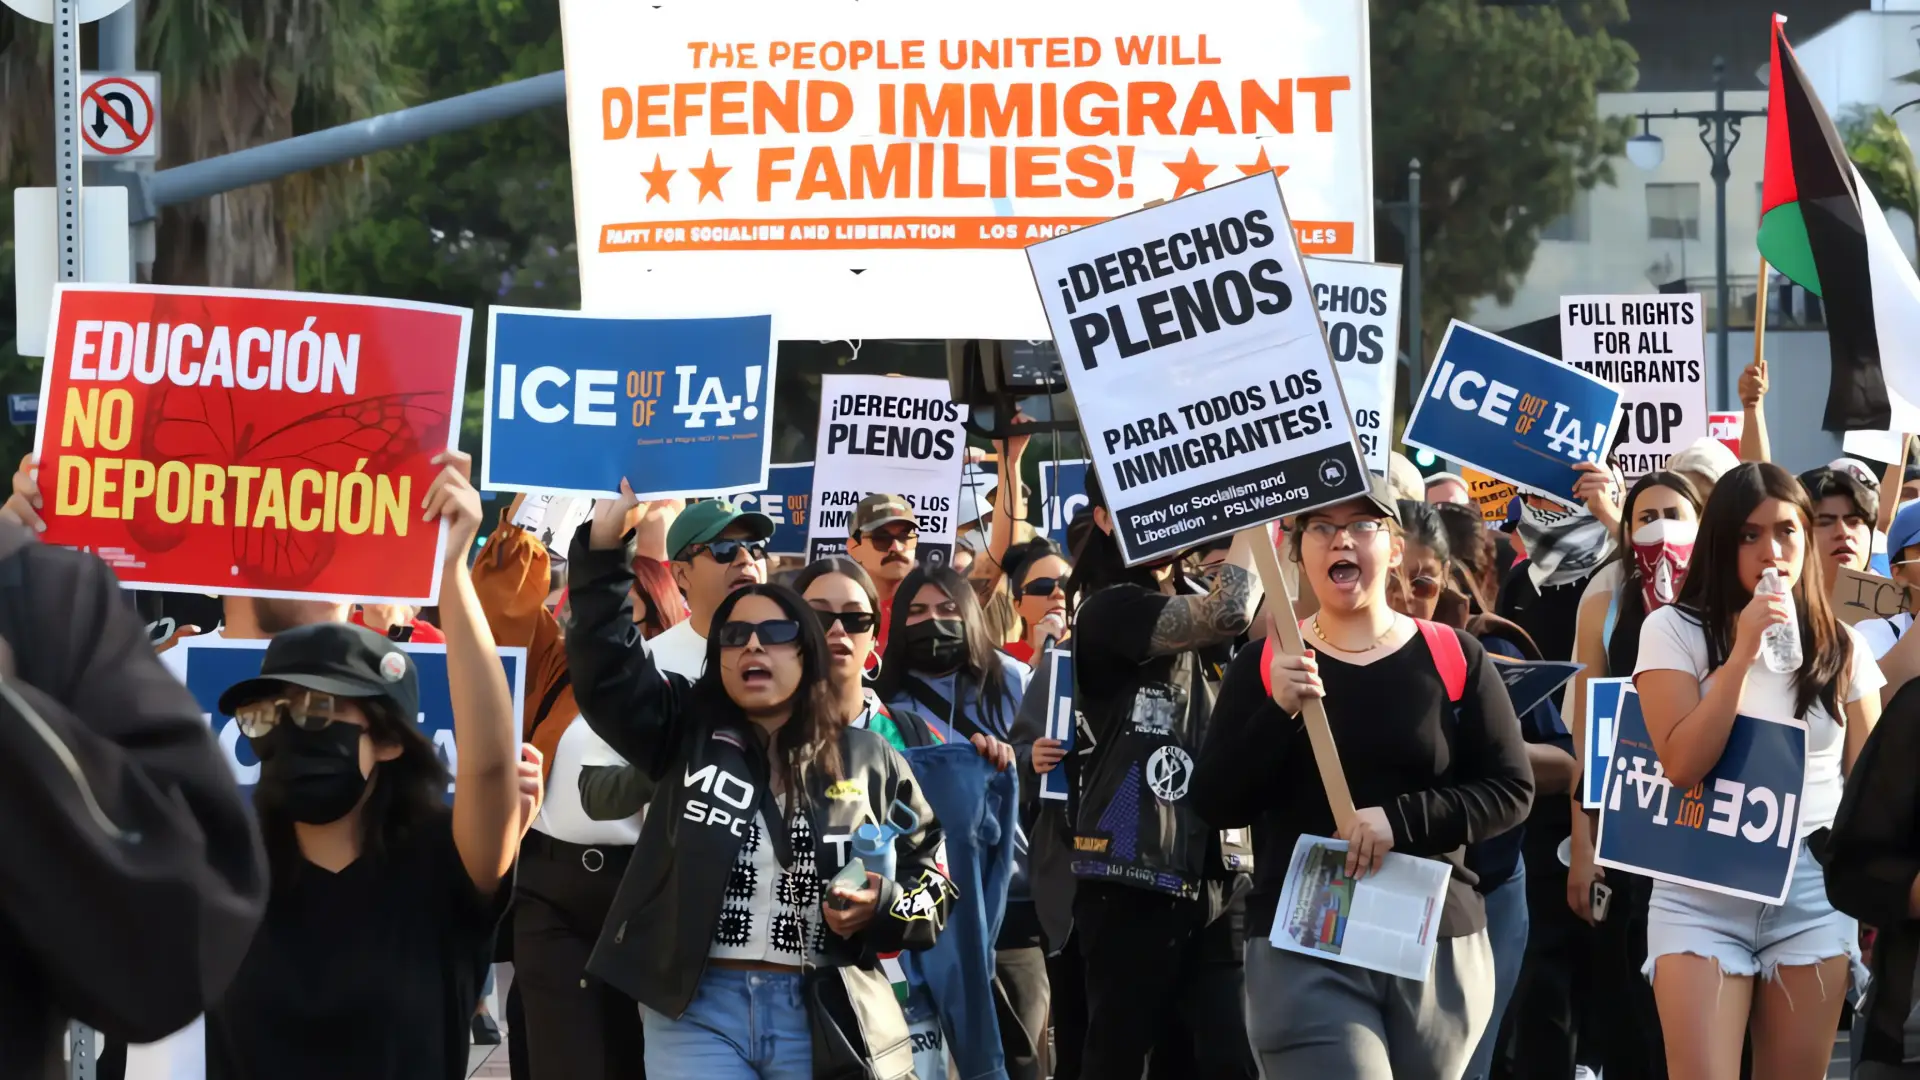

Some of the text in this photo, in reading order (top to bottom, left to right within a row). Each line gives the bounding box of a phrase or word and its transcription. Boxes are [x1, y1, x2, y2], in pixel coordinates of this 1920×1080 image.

[687, 34, 1221, 71] THE PEOPLE UNITED WILL
[602, 76, 1351, 140] DEFEND IMMIGRANT
[757, 143, 1135, 202] FAMILIES!
[606, 229, 650, 244] PARTY
[655, 228, 686, 243] FOR
[690, 226, 785, 242] SOCIALISM
[790, 224, 830, 240] AND
[836, 224, 955, 241] LIBERATION
[979, 224, 1018, 239] LOS
[1296, 228, 1337, 244] LES
[1057, 210, 1275, 314] ¡DERECHOS
[1070, 259, 1293, 371] PLENOS
[1313, 283, 1388, 316] CHOS
[1568, 302, 1694, 326] FULL RIGHTS
[69, 316, 361, 395] EDUCACIÓN
[1594, 331, 1673, 354] FOR ALL
[499, 364, 762, 428] ICE OUT OF LA!
[832, 395, 959, 422] ¡DERECHOS
[1103, 368, 1322, 455] PARA TODOS LOS
[1431, 360, 1519, 426] ICE
[1518, 392, 1548, 418] OUT
[61, 387, 134, 451] NO
[1355, 409, 1380, 429] OS
[1515, 415, 1537, 435] OF
[1620, 402, 1683, 444] TOP
[827, 424, 955, 461] PLENOS
[1113, 400, 1333, 491] INMIGRANTES!
[55, 455, 412, 537] DEPORTACIÓN
[788, 495, 808, 510] OUT
[821, 491, 859, 506] PARA
[921, 496, 950, 512] LOS
[1050, 493, 1090, 529] IC
[1131, 472, 1286, 528] Party for Socialism and
[792, 511, 805, 525] OF
[1136, 486, 1309, 546] Liberation PSLWeb.org
[1674, 797, 1705, 829] OUT
[1707, 778, 1796, 849] ICE
